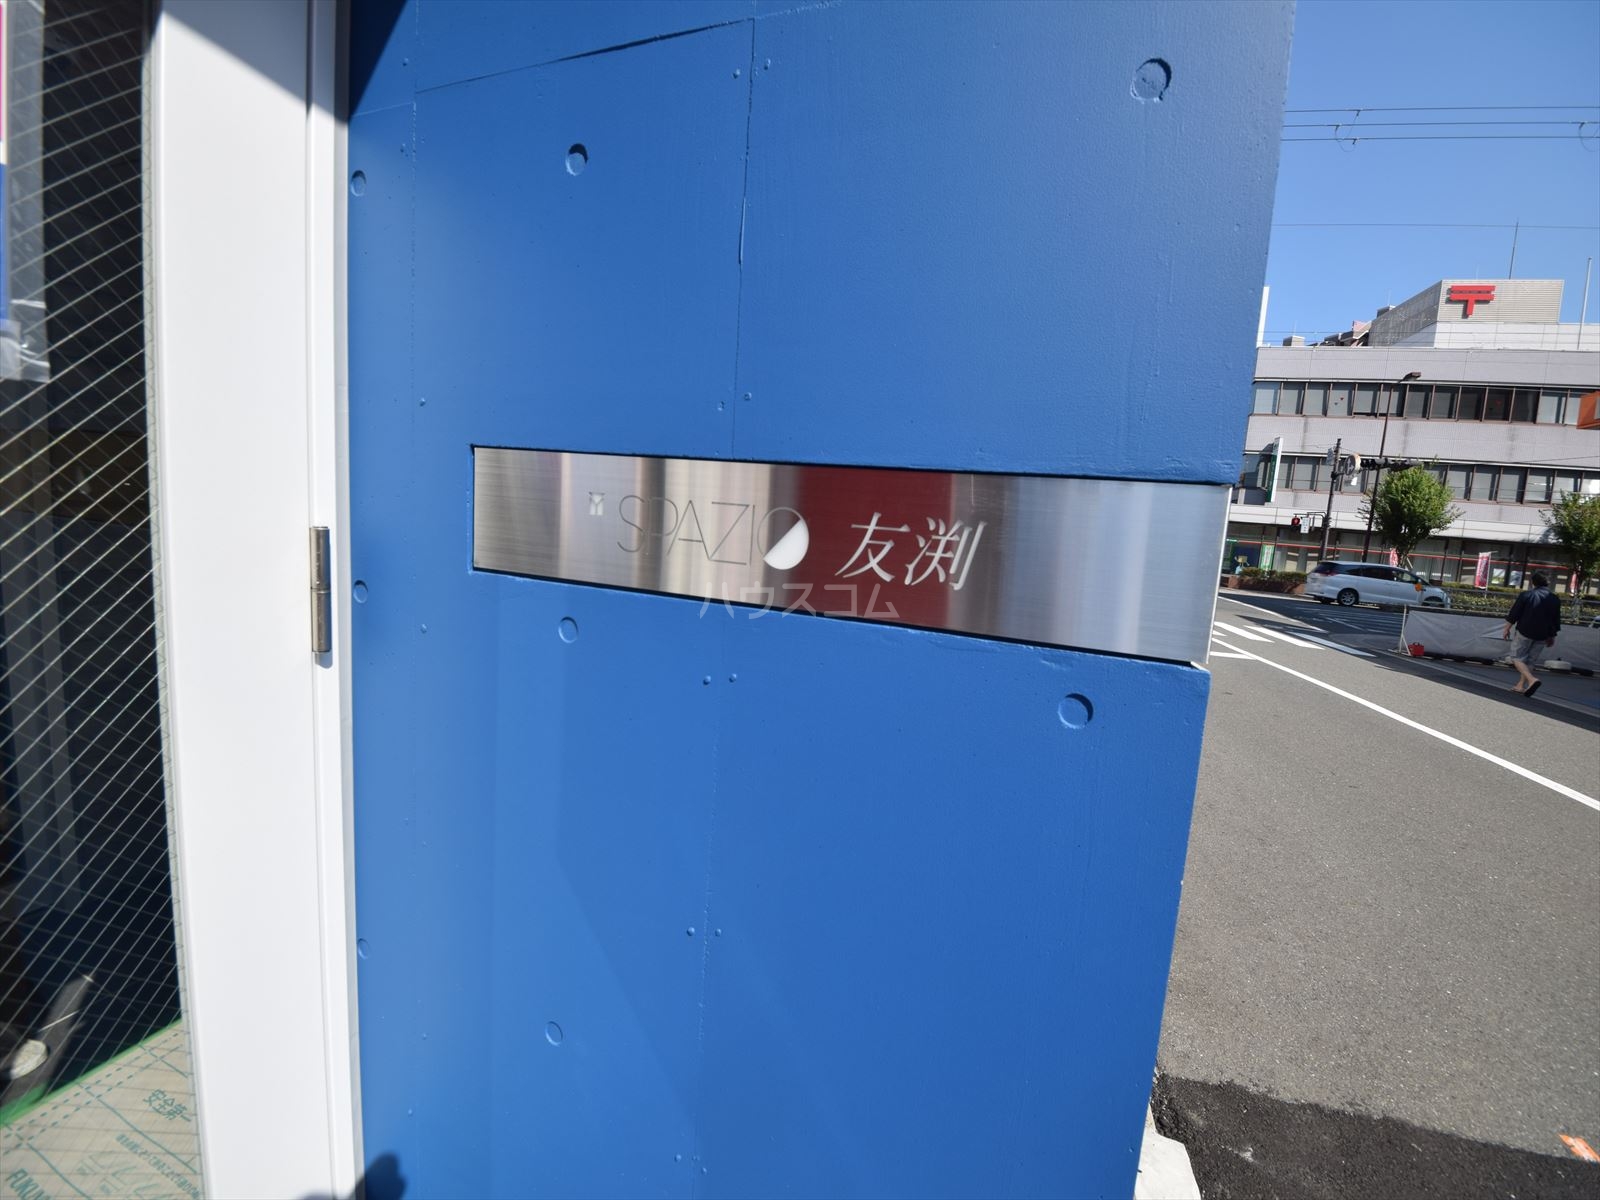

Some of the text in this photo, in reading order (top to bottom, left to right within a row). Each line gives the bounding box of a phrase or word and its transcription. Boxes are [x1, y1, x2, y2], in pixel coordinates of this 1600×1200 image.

[616, 494, 988, 591] SPAZIO 友渕
[143, 1088, 192, 1123] 安全第一
